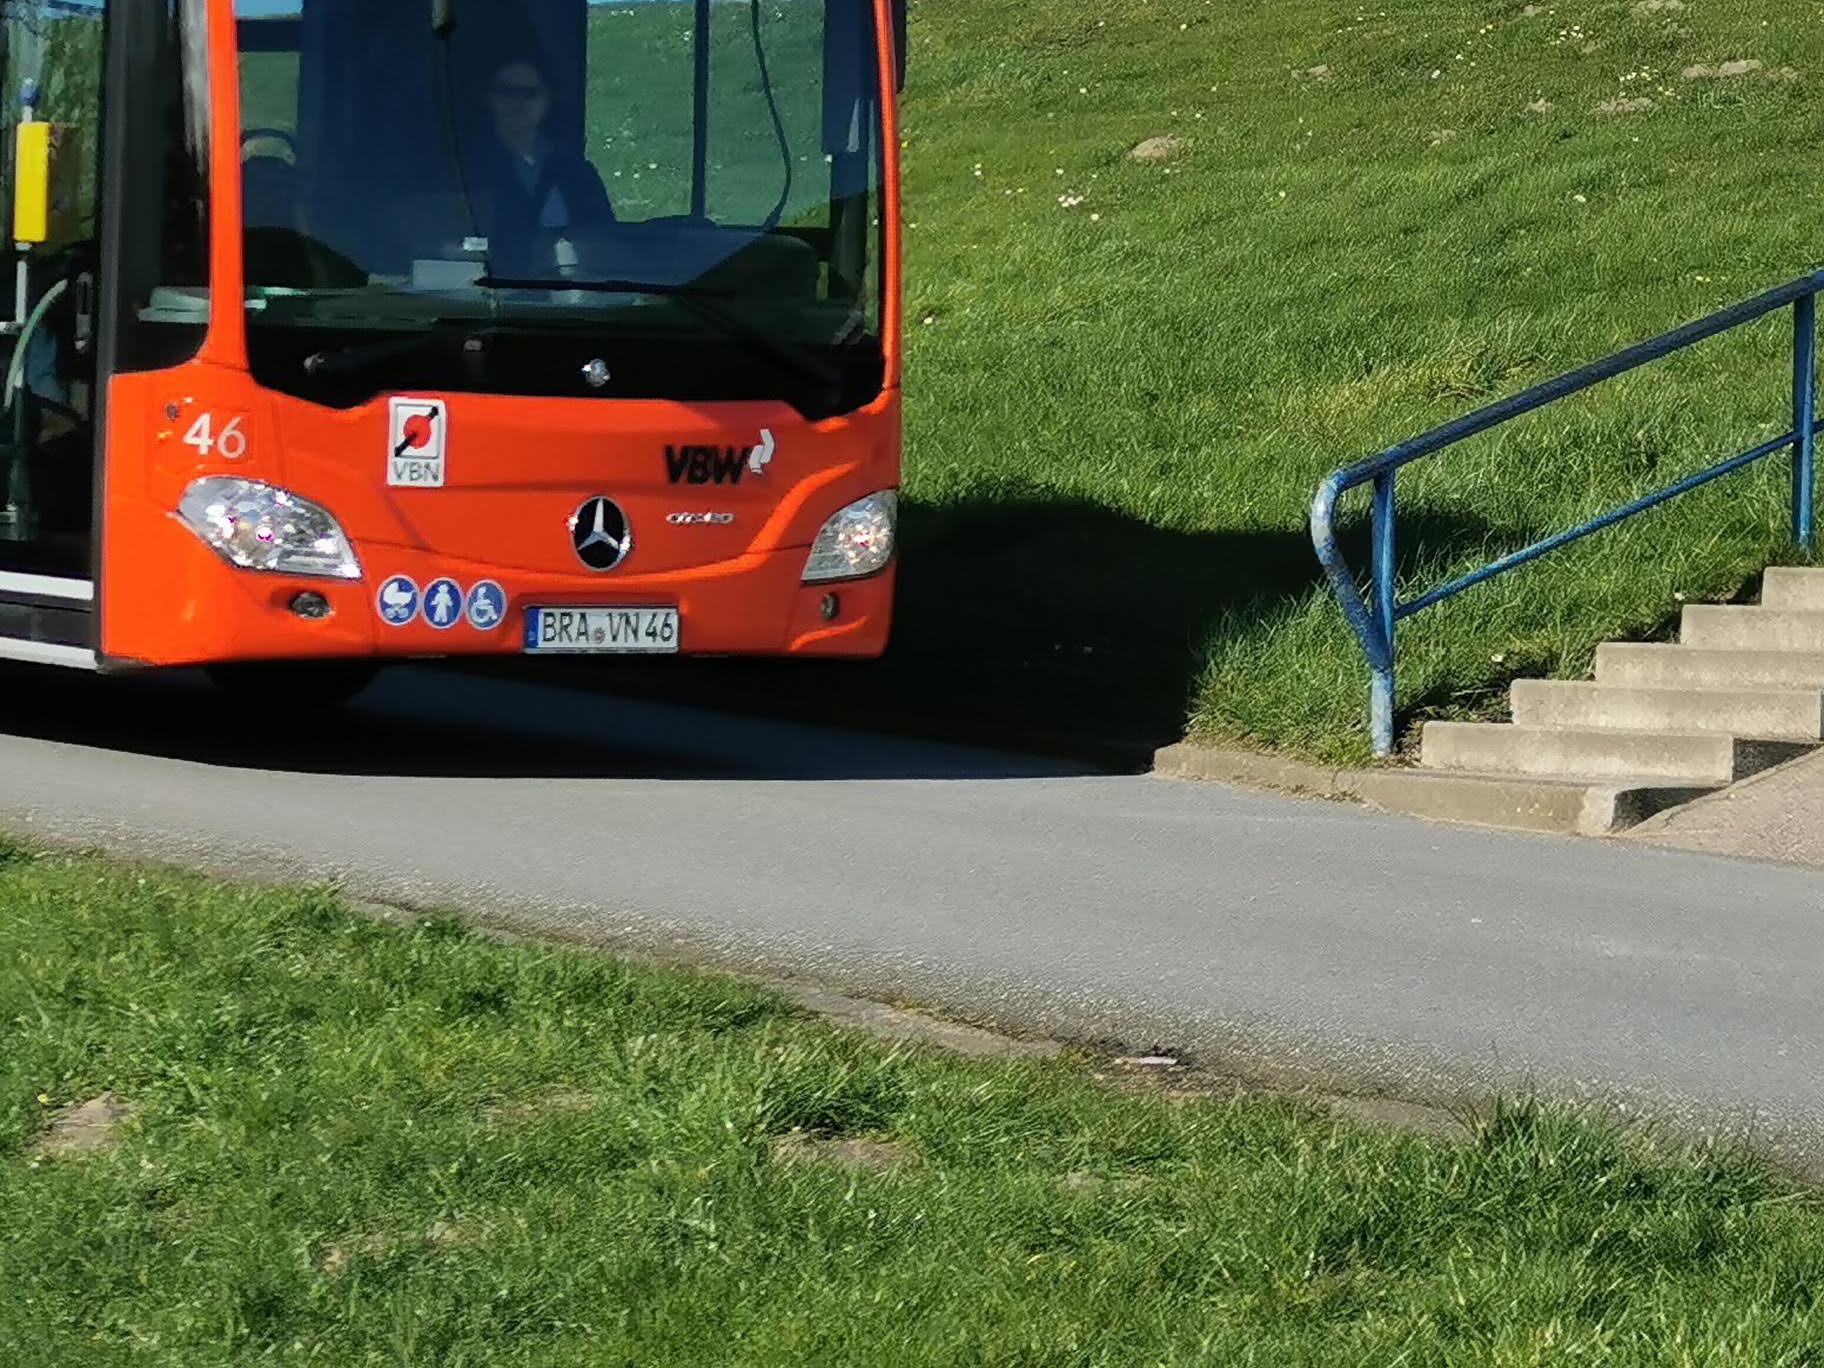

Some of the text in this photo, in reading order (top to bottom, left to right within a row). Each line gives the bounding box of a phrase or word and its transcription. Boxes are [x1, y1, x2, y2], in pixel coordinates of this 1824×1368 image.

[182, 412, 246, 459] 46
[392, 460, 440, 483] VBN
[664, 443, 753, 485] VBW
[542, 610, 675, 643] BRA VN 46
